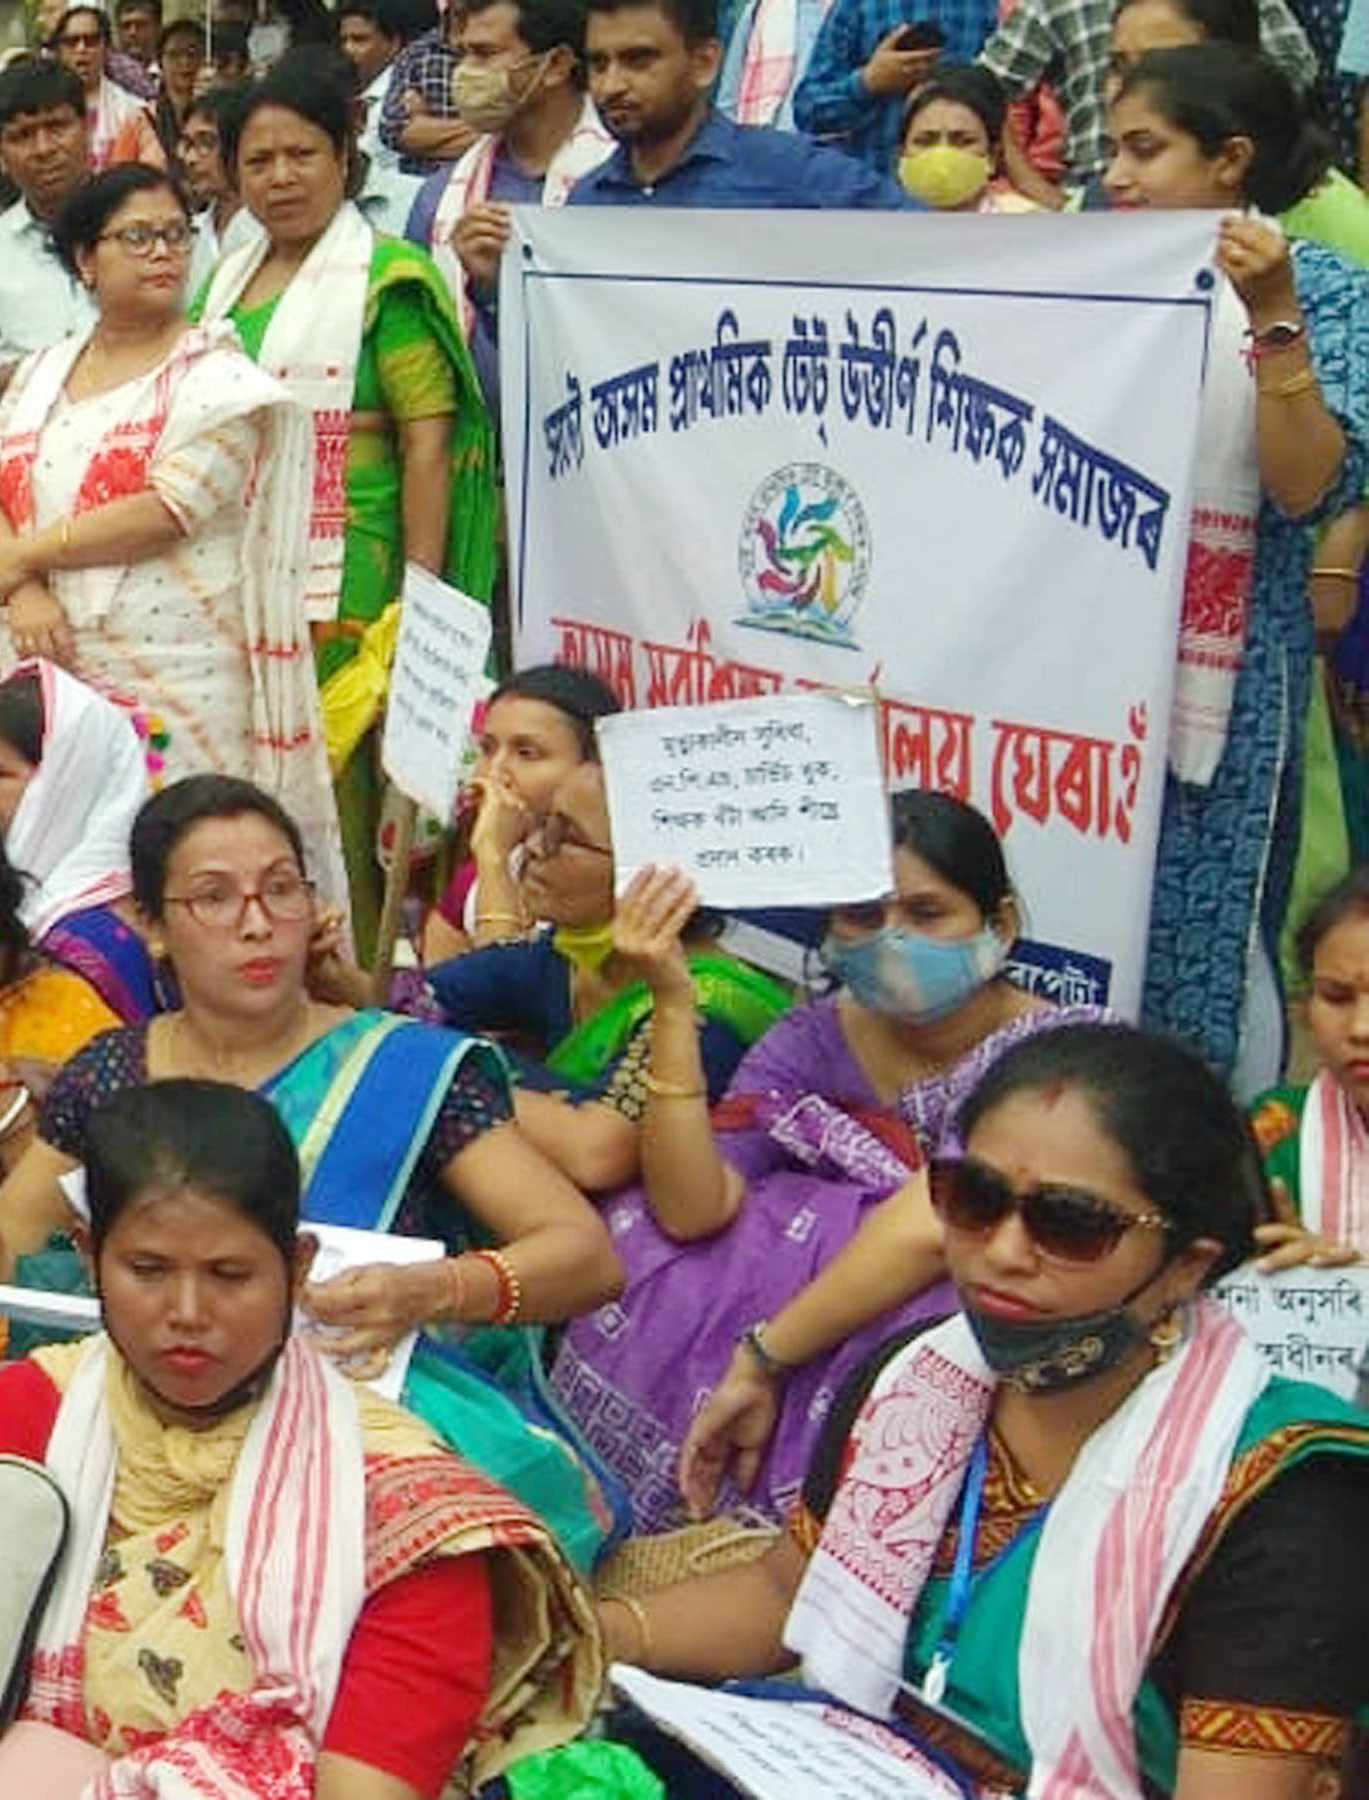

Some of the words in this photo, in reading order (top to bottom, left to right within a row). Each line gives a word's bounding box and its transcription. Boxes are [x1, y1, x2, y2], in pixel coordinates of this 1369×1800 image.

[589, 360, 660, 450] অসম
[668, 308, 773, 433] প্ৰাথমিক
[838, 307, 928, 436] উত্তীৰ্ণ
[928, 328, 1035, 481] শিক্ষক
[1032, 414, 1172, 572] সমাজৰ
